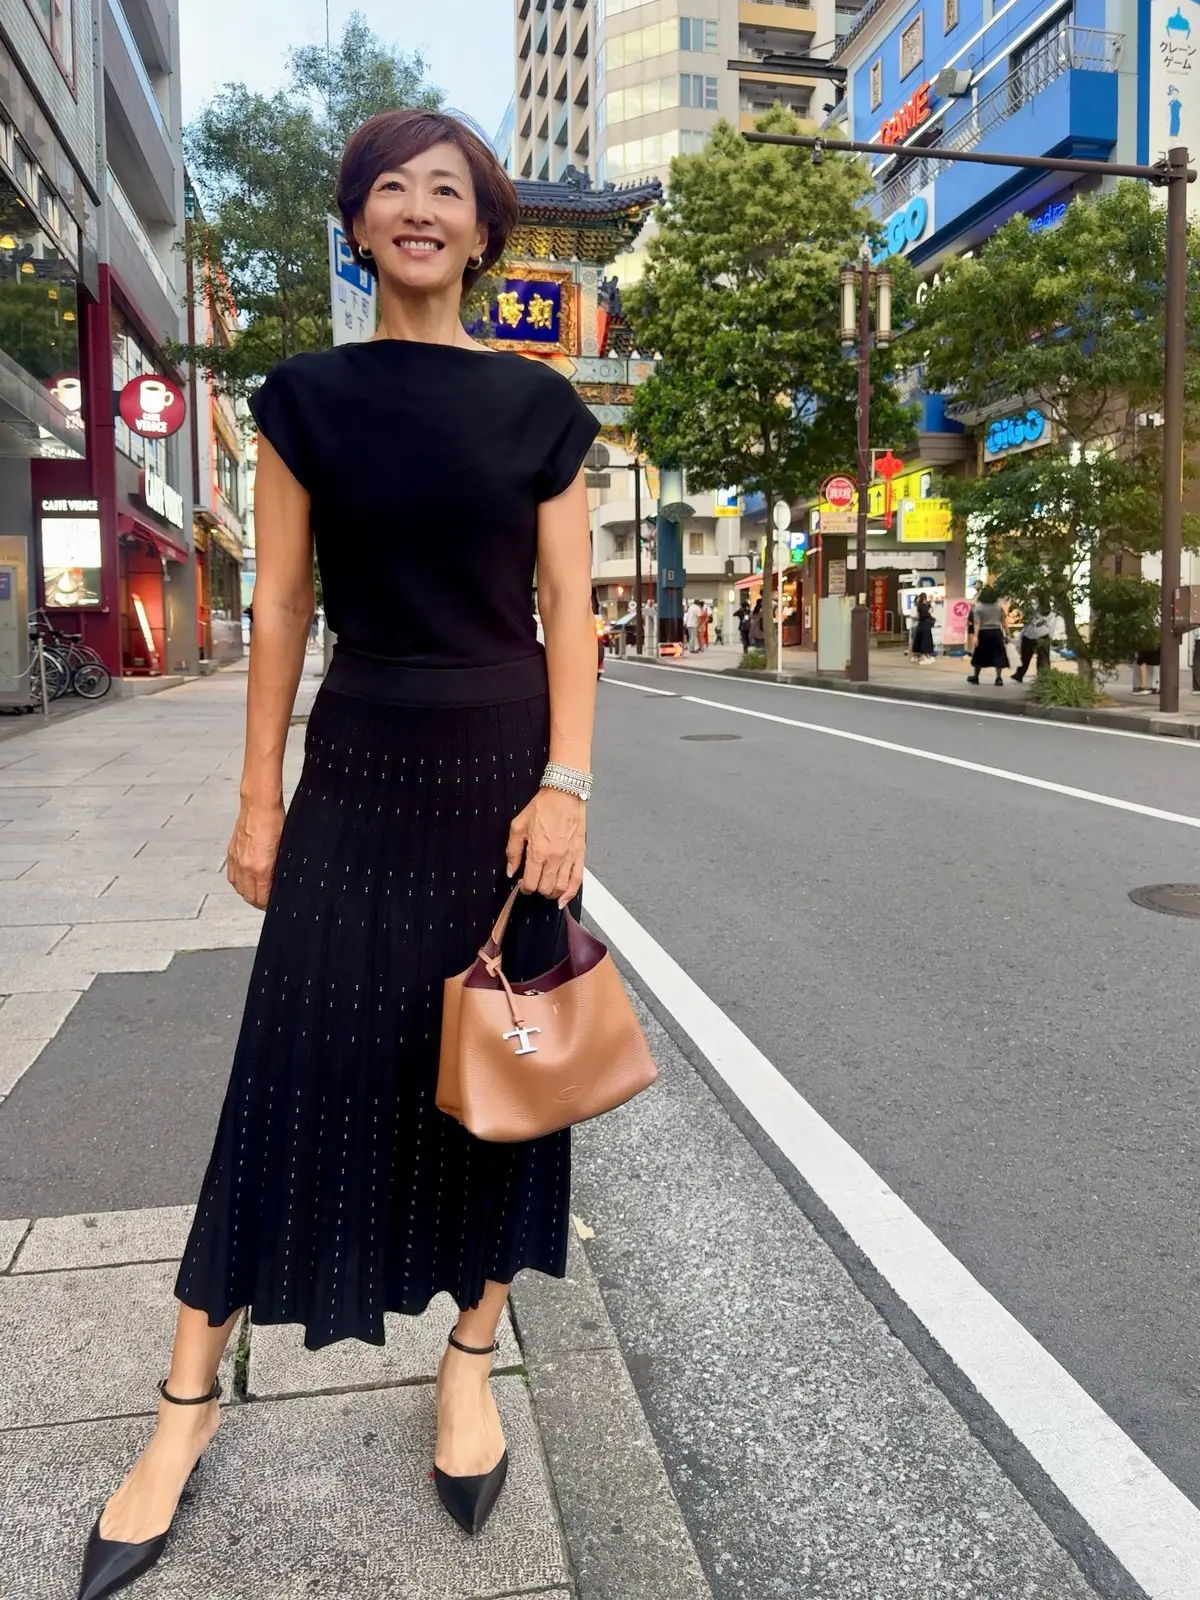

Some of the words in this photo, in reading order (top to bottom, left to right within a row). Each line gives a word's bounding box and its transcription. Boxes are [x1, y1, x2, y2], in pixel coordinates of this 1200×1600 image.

[1159, 41, 1197, 57] クレーン
[1163, 55, 1193, 70] ゲーム
[880, 81, 931, 147] GAME
[791, 532, 805, 550] P
